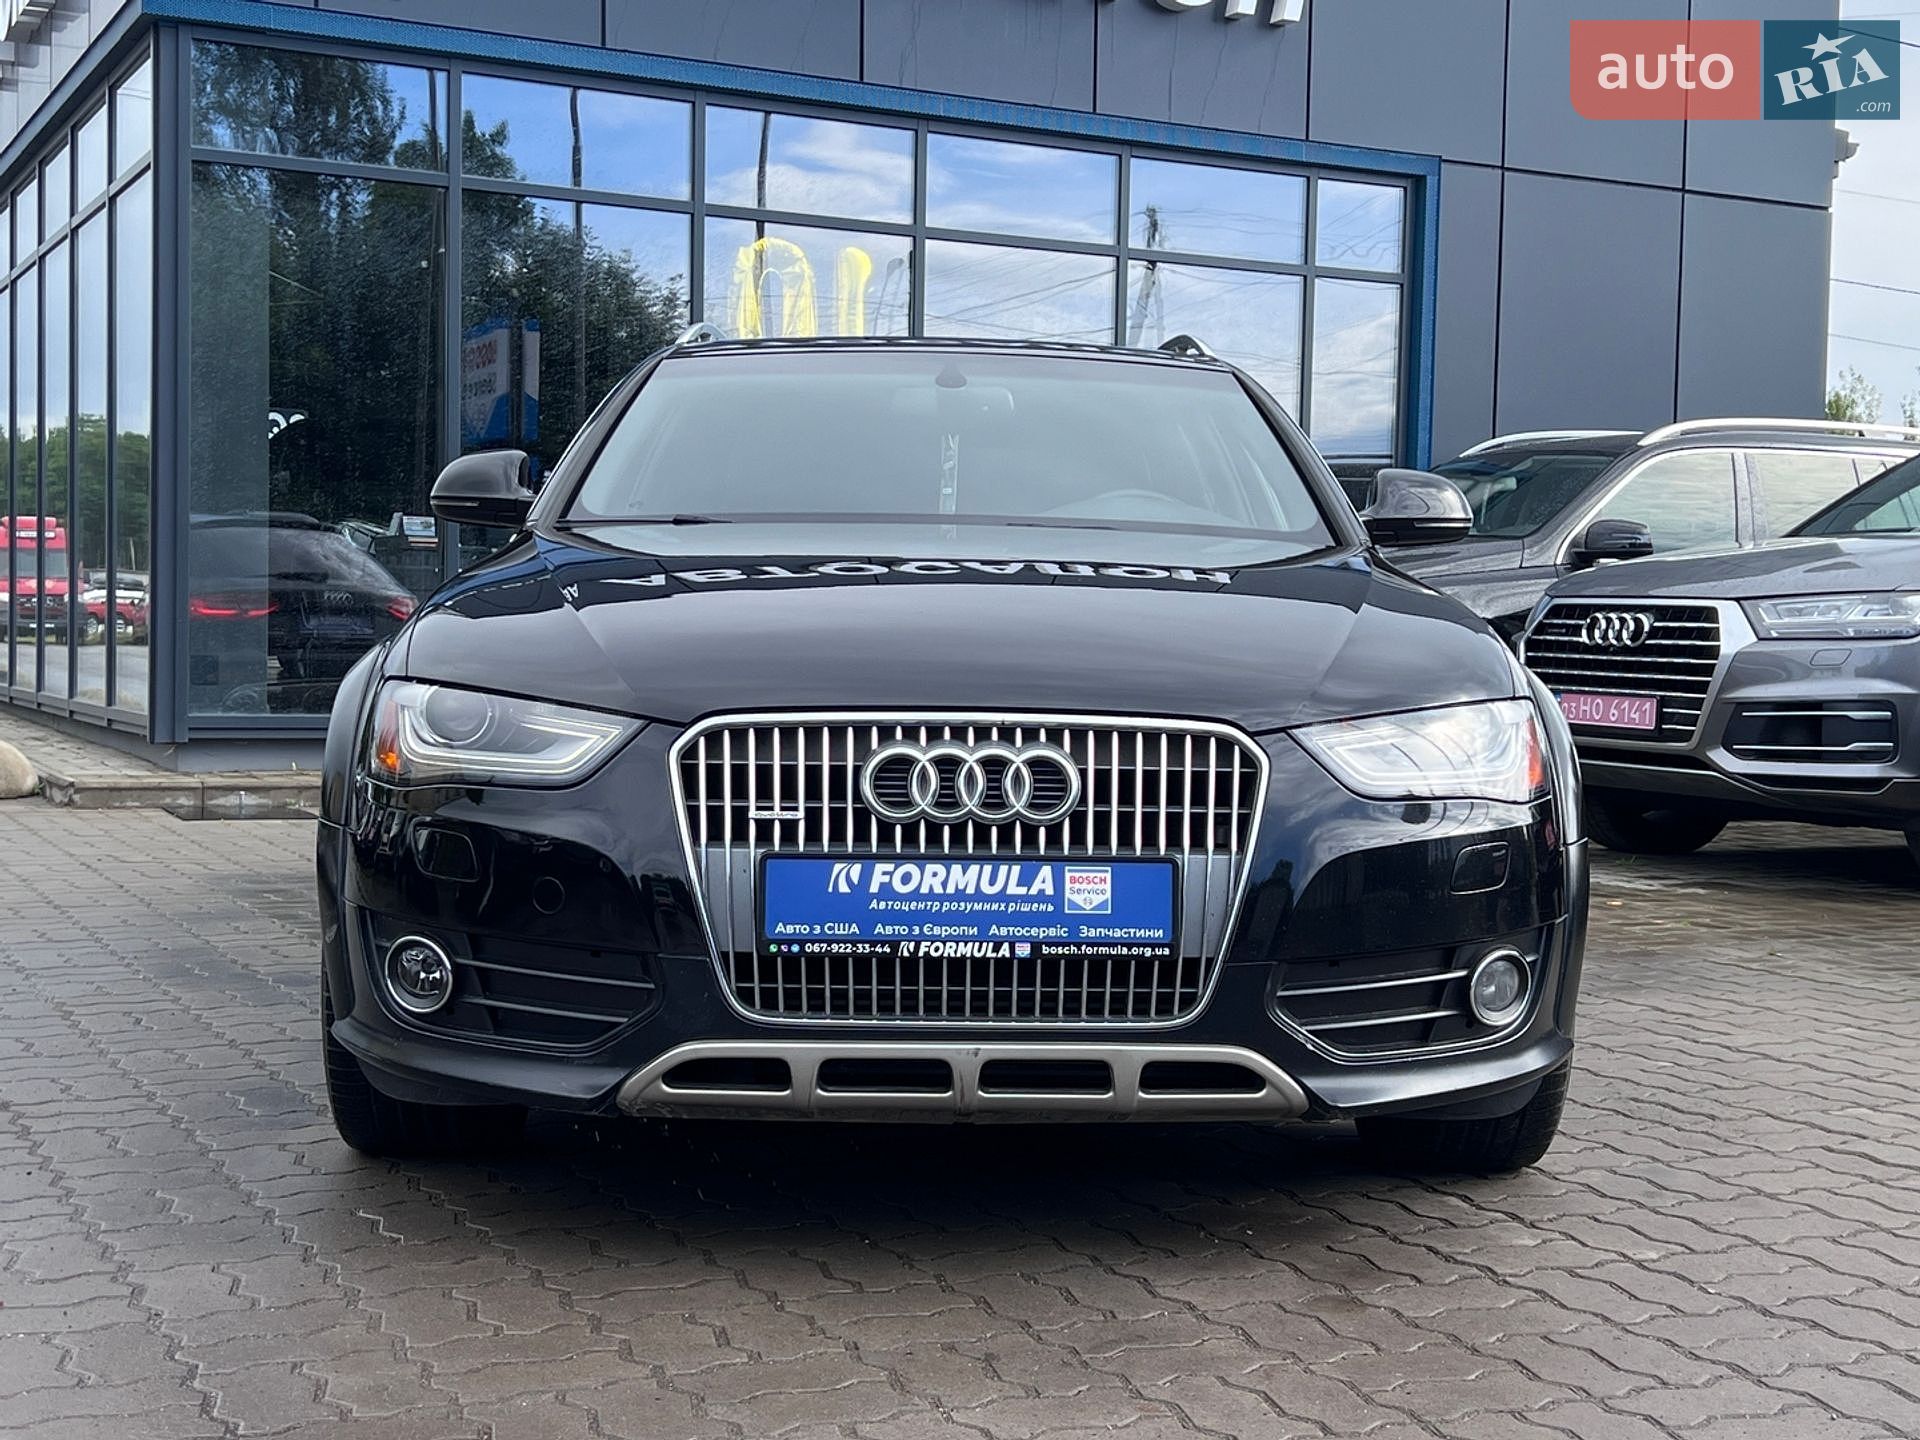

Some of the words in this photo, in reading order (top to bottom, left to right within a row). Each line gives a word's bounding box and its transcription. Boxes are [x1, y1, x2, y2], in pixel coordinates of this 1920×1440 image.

[1609, 699, 1652, 724] 6141
[869, 863, 1055, 896] FORMULA
[1069, 875, 1107, 885] BOSCH
[1069, 886, 1107, 896] Service
[869, 898, 940, 912] Автоцентр
[941, 900, 1006, 913] розумних
[1008, 900, 1055, 913] рішень
[774, 922, 810, 934] Авто
[824, 922, 860, 934] США
[873, 923, 908, 935] Авто
[922, 923, 978, 938] Європи
[988, 924, 1069, 939] Автосервіс
[1079, 925, 1163, 938] Запчастини
[804, 942, 891, 953] 067-922-33-44
[918, 941, 1011, 958] FORMULA
[1041, 944, 1170, 957] bosch.formula.org.ua
